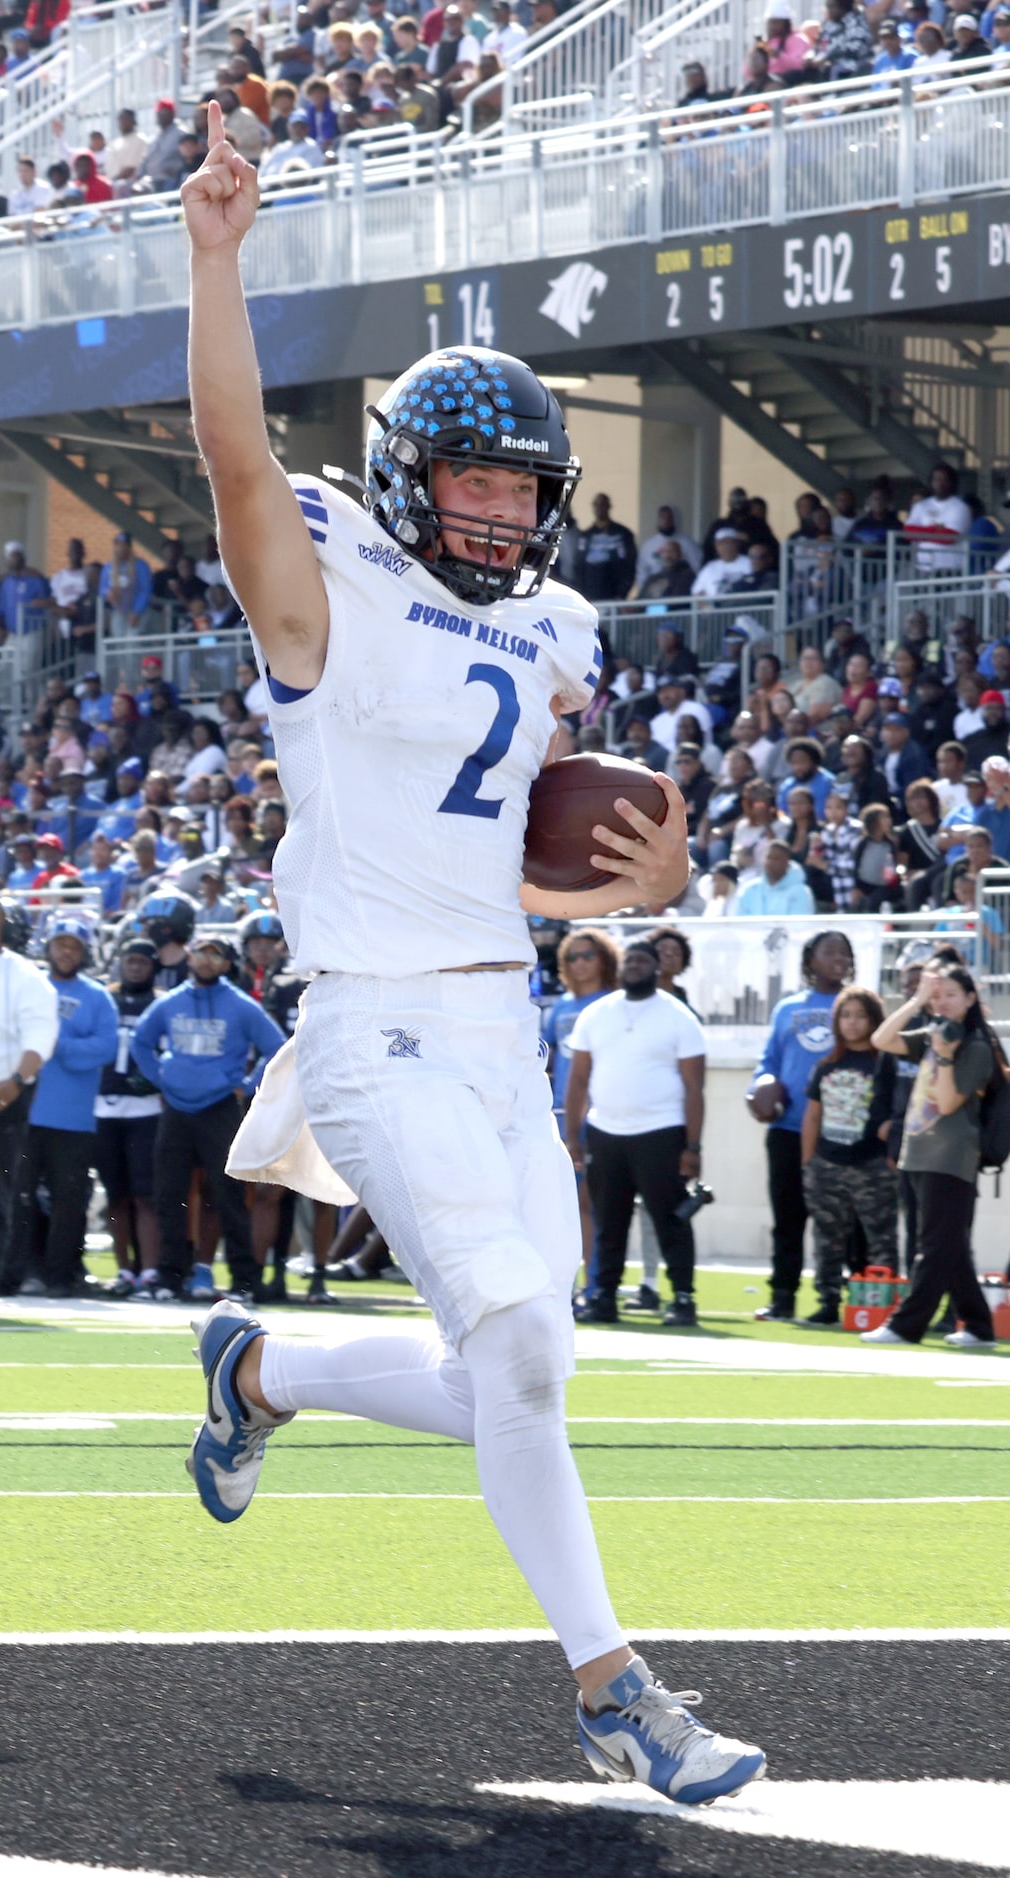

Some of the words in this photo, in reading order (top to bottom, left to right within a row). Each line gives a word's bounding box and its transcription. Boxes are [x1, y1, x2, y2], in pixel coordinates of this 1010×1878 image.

[885, 218, 909, 244] QTR
[920, 215, 949, 240] BALL
[950, 211, 968, 236] ON
[656, 250, 691, 275] DOWN
[700, 245, 715, 268] TO
[716, 243, 733, 267] GO
[784, 233, 853, 309] 5:02
[889, 252, 905, 300] 2
[936, 246, 951, 293] 5
[458, 280, 495, 346] 14
[666, 282, 681, 328] 2
[709, 275, 724, 322] 5
[500, 434, 550, 454] Riddell
[404, 601, 473, 638] BYRON
[475, 623, 540, 664] NELSON
[436, 662, 521, 819] 2
[854, 1310, 870, 1328] G
